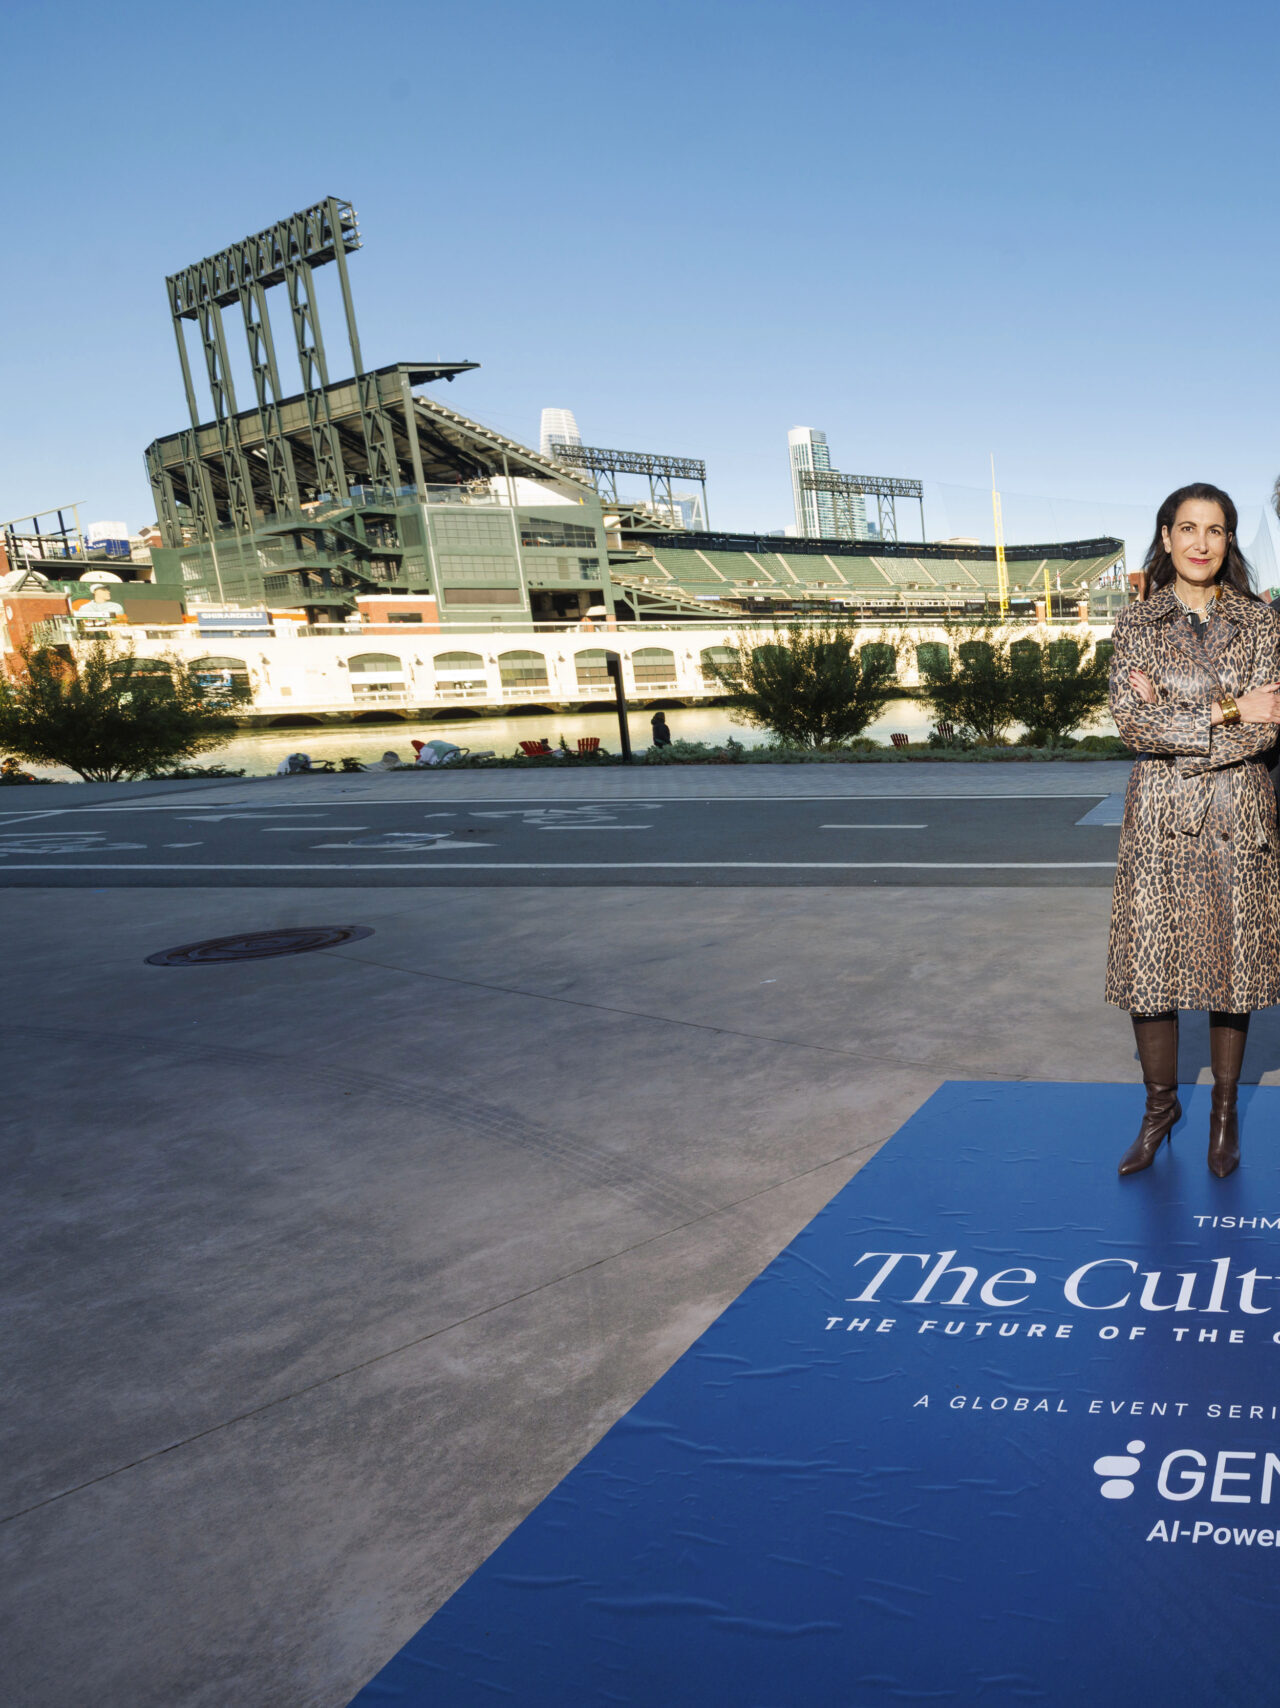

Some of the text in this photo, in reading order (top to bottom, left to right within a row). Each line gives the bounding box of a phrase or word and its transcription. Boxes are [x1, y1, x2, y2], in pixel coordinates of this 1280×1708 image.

[845, 1249, 1037, 1307] The
[825, 1317, 897, 1333] THE
[918, 1320, 1074, 1338] FUTURE
[1098, 1325, 1147, 1340] OF
[1172, 1327, 1245, 1344] THE
[913, 1394, 931, 1408] A
[949, 1395, 1069, 1413] GLOBAL
[1088, 1400, 1189, 1417] EVENT
